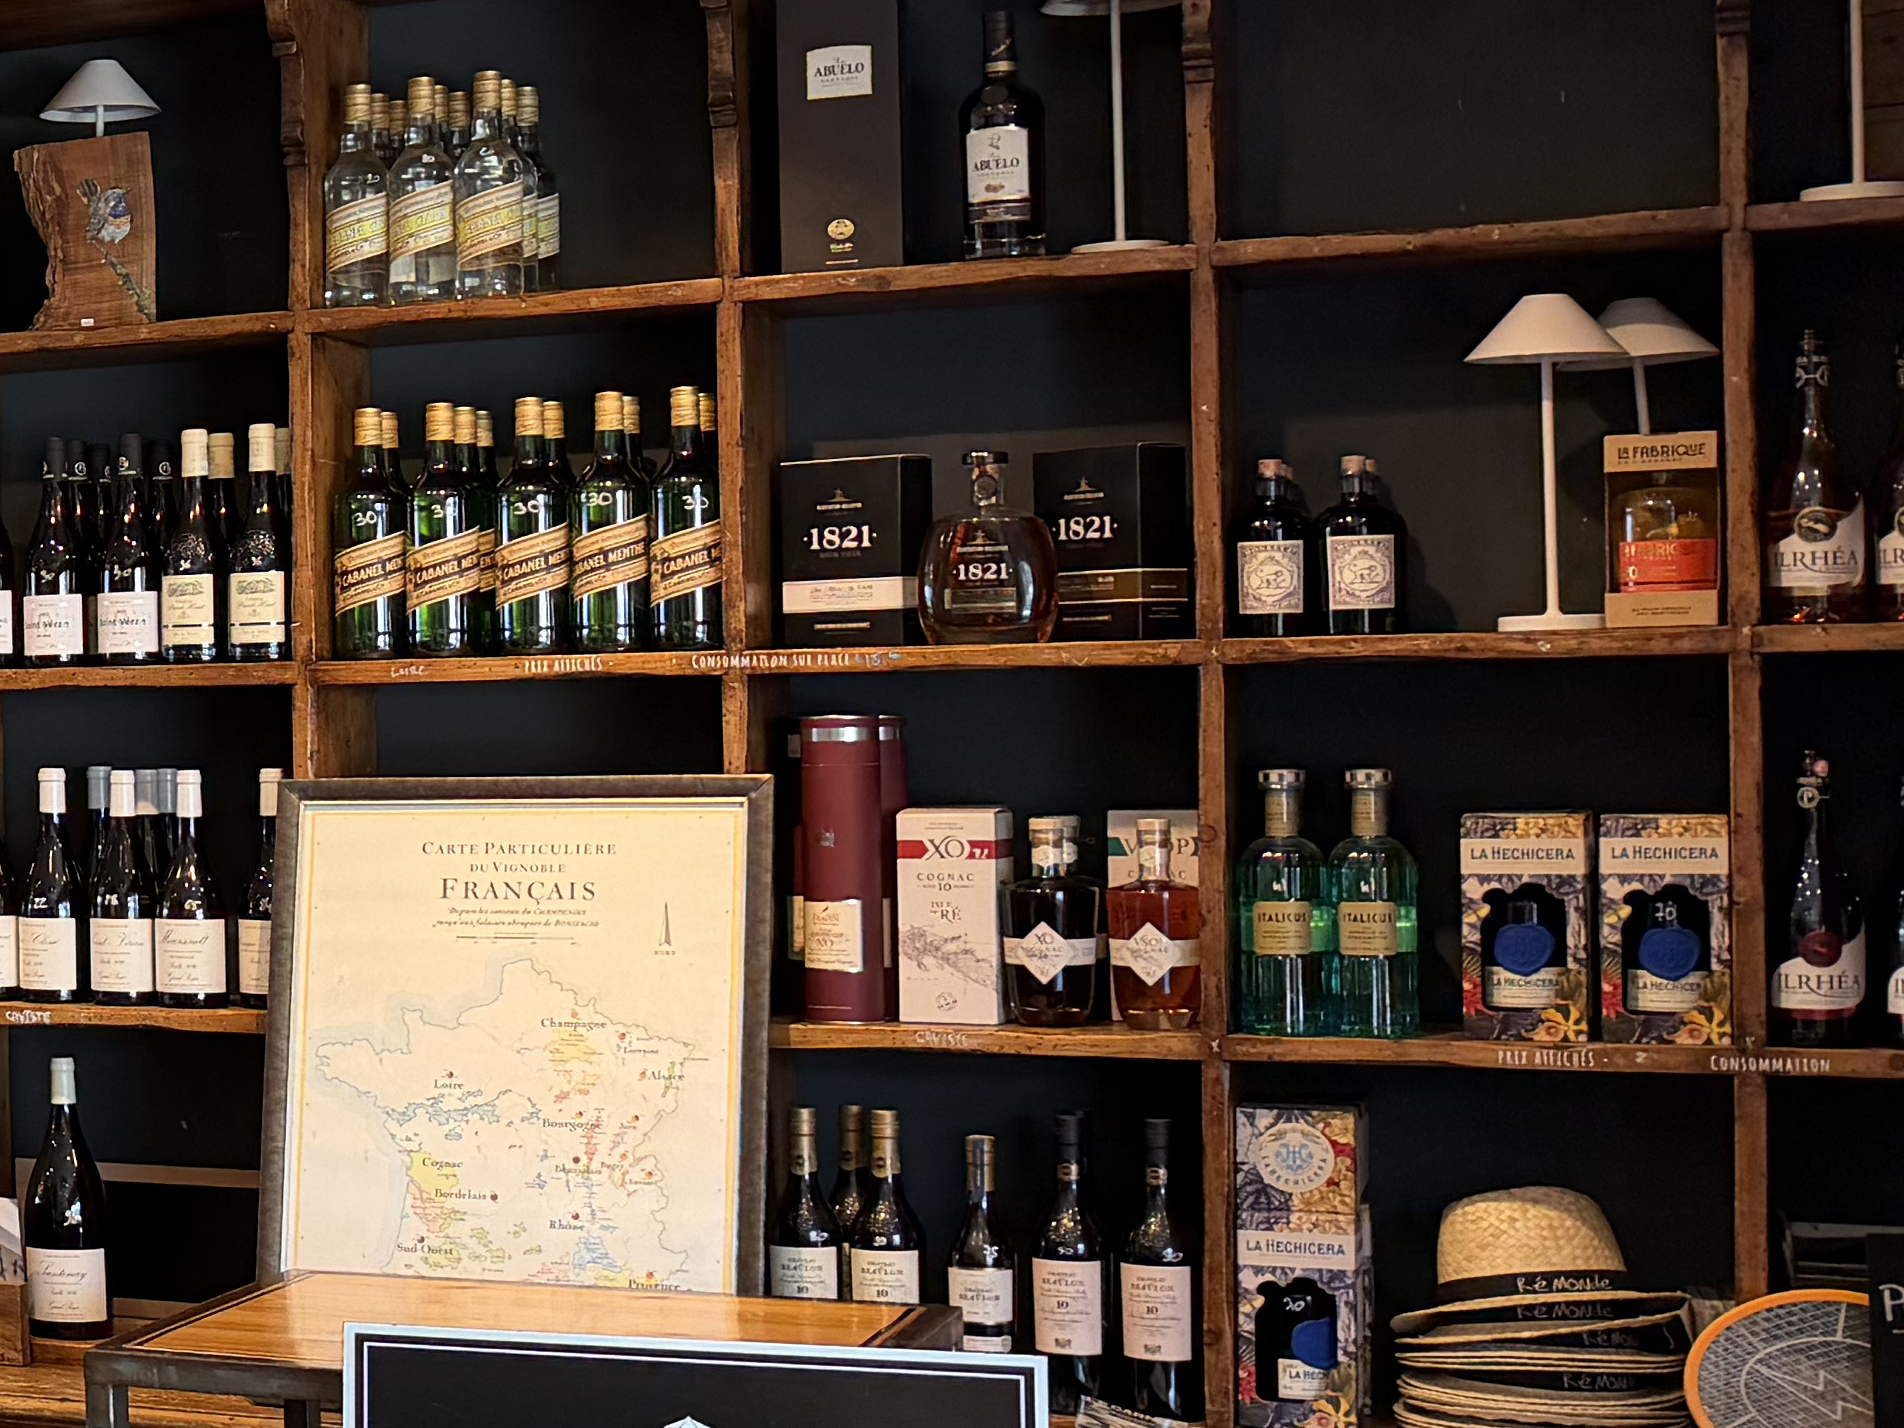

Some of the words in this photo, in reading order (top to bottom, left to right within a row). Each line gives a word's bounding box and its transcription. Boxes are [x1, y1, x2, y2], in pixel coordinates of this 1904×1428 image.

[813, 62, 866, 79] ABUELO
[972, 156, 1021, 173] ABUELO
[1632, 443, 1707, 459] FABRIQUE
[514, 498, 541, 515] 30
[586, 491, 612, 508] 30
[682, 493, 709, 510] 30
[353, 510, 377, 527] 30
[1056, 516, 1114, 541] 1821
[808, 525, 873, 551] 1821
[956, 562, 1010, 581] 1821
[422, 841, 478, 855] CARTE
[485, 841, 617, 855] PARTICULIÈRE
[925, 835, 965, 860] XO
[1470, 848, 1488, 860] LA
[1491, 846, 1575, 860] HECHICERA
[1611, 847, 1629, 859] LA
[1632, 845, 1719, 860] HECHICERA
[493, 861, 566, 873] VIGNOBLE
[917, 872, 974, 882] COGNAC
[439, 878, 596, 905] FRANÇAIS
[1257, 912, 1307, 923] ITALICUS
[1343, 912, 1392, 923] ITALICUS
[540, 1018, 607, 1033] Champagne
[1710, 1055, 1831, 1072] CONSOMMATION
[434, 1079, 463, 1090] Loire
[422, 1157, 463, 1170] Cognac
[1246, 1240, 1262, 1252] LA
[1266, 1239, 1346, 1256] HECHICERA
